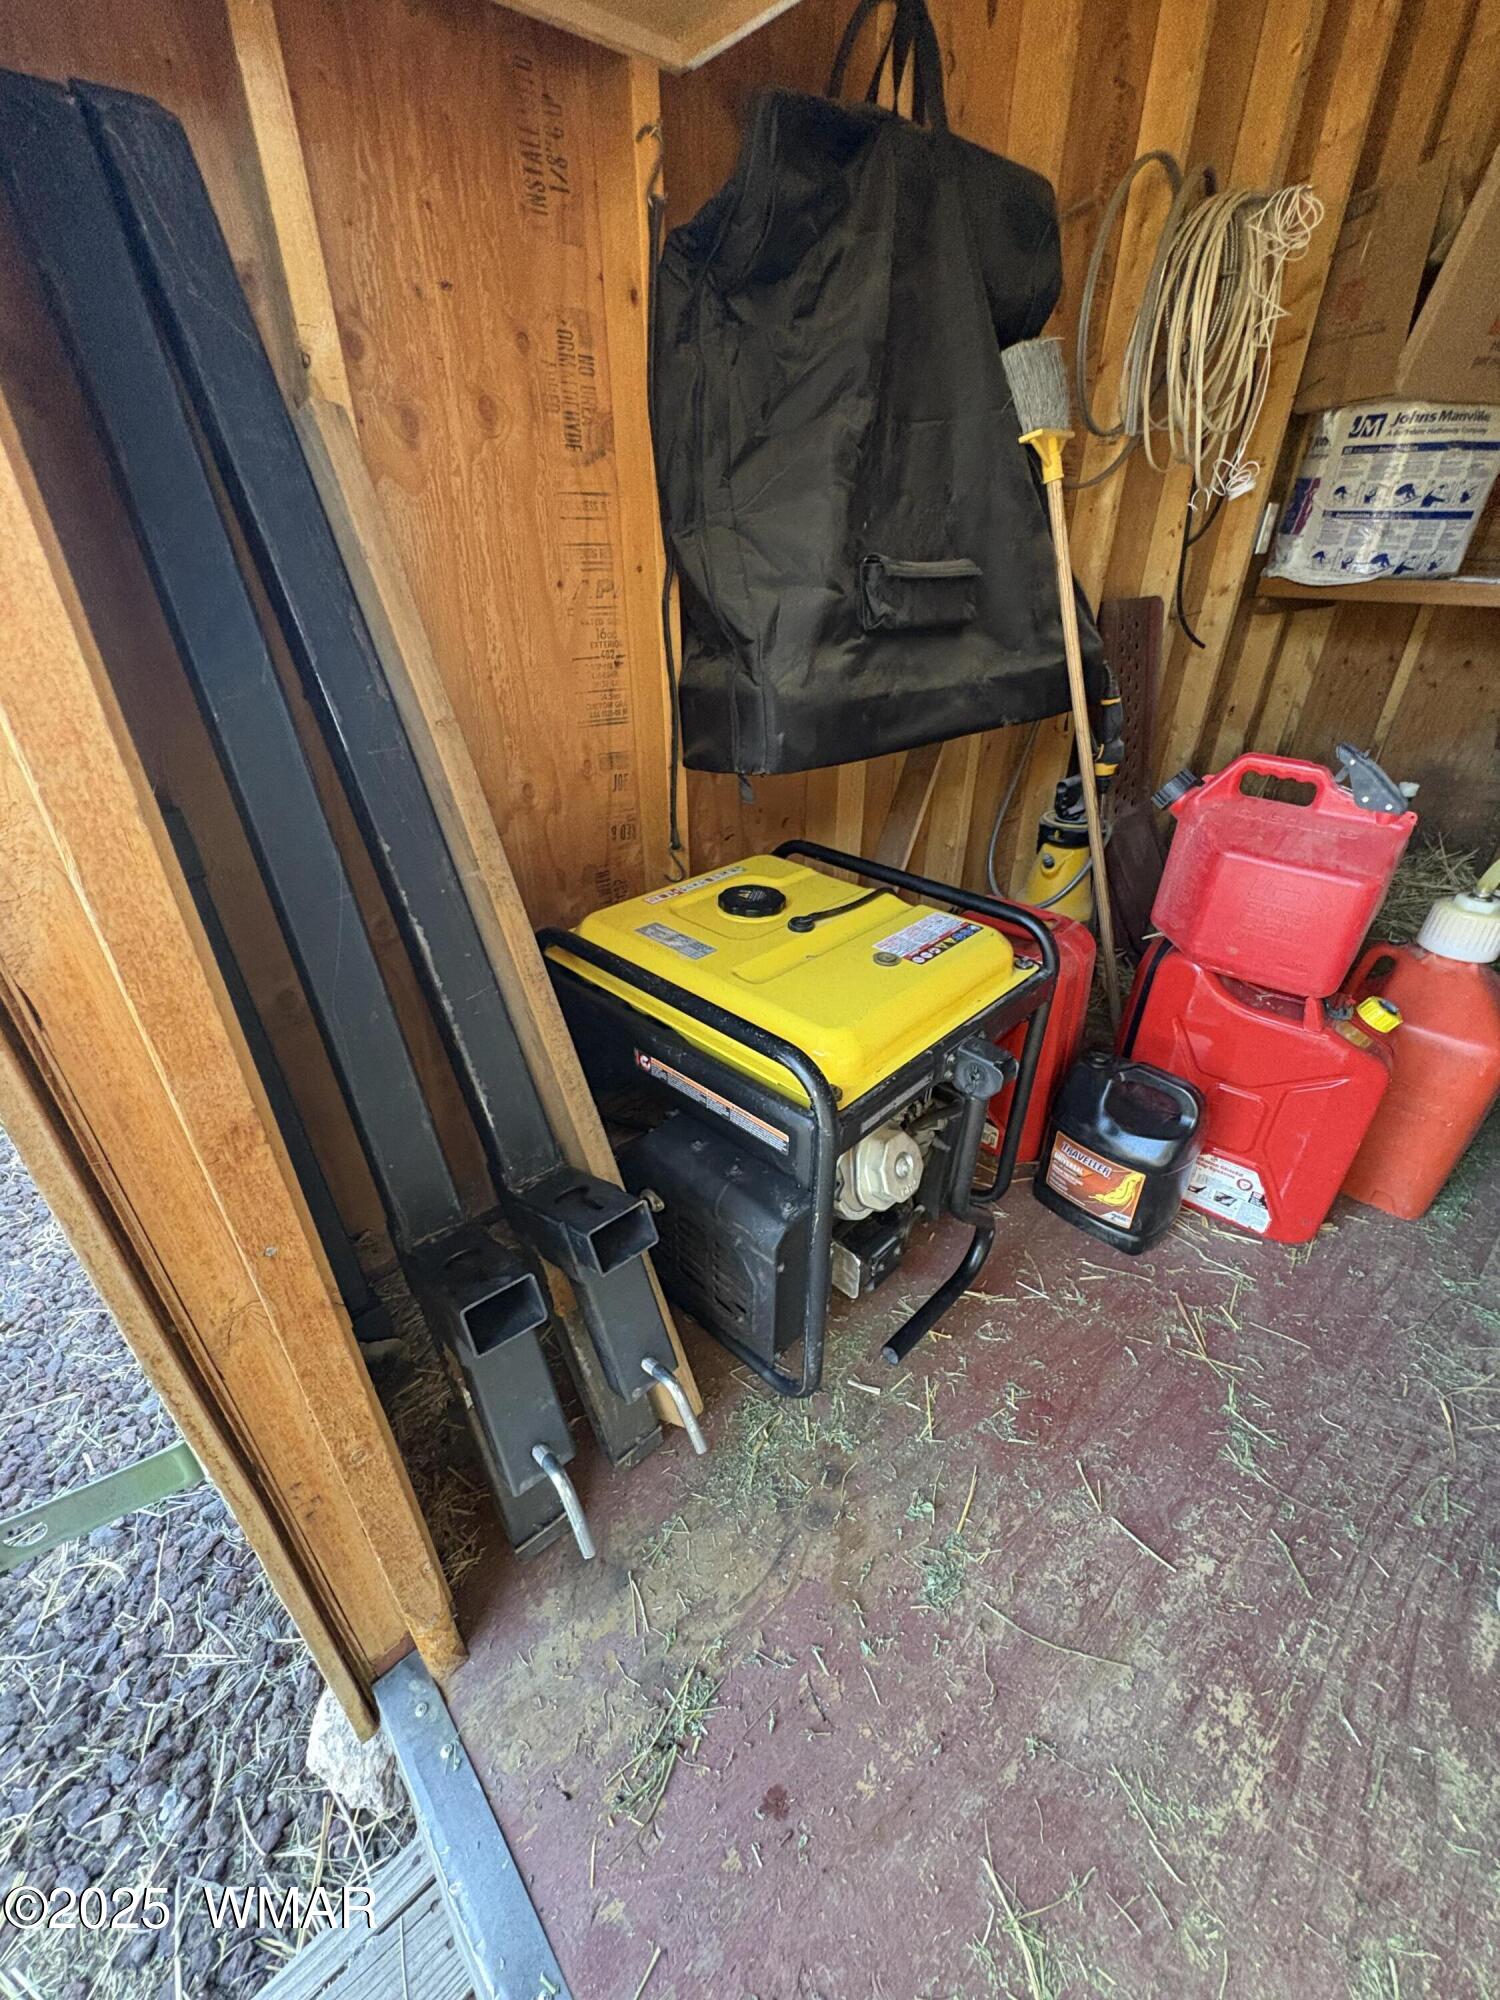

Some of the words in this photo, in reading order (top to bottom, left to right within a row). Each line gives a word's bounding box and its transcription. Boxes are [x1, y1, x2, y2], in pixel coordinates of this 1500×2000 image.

[578, 353, 596, 379] NO
[557, 320, 583, 453] ORMLDEHYDE
[1390, 412, 1437, 427] Johns
[1440, 410, 1490, 425] Manville
[590, 640, 623, 649] EXTERIO
[1062, 1142, 1112, 1178] TRAVELLER
